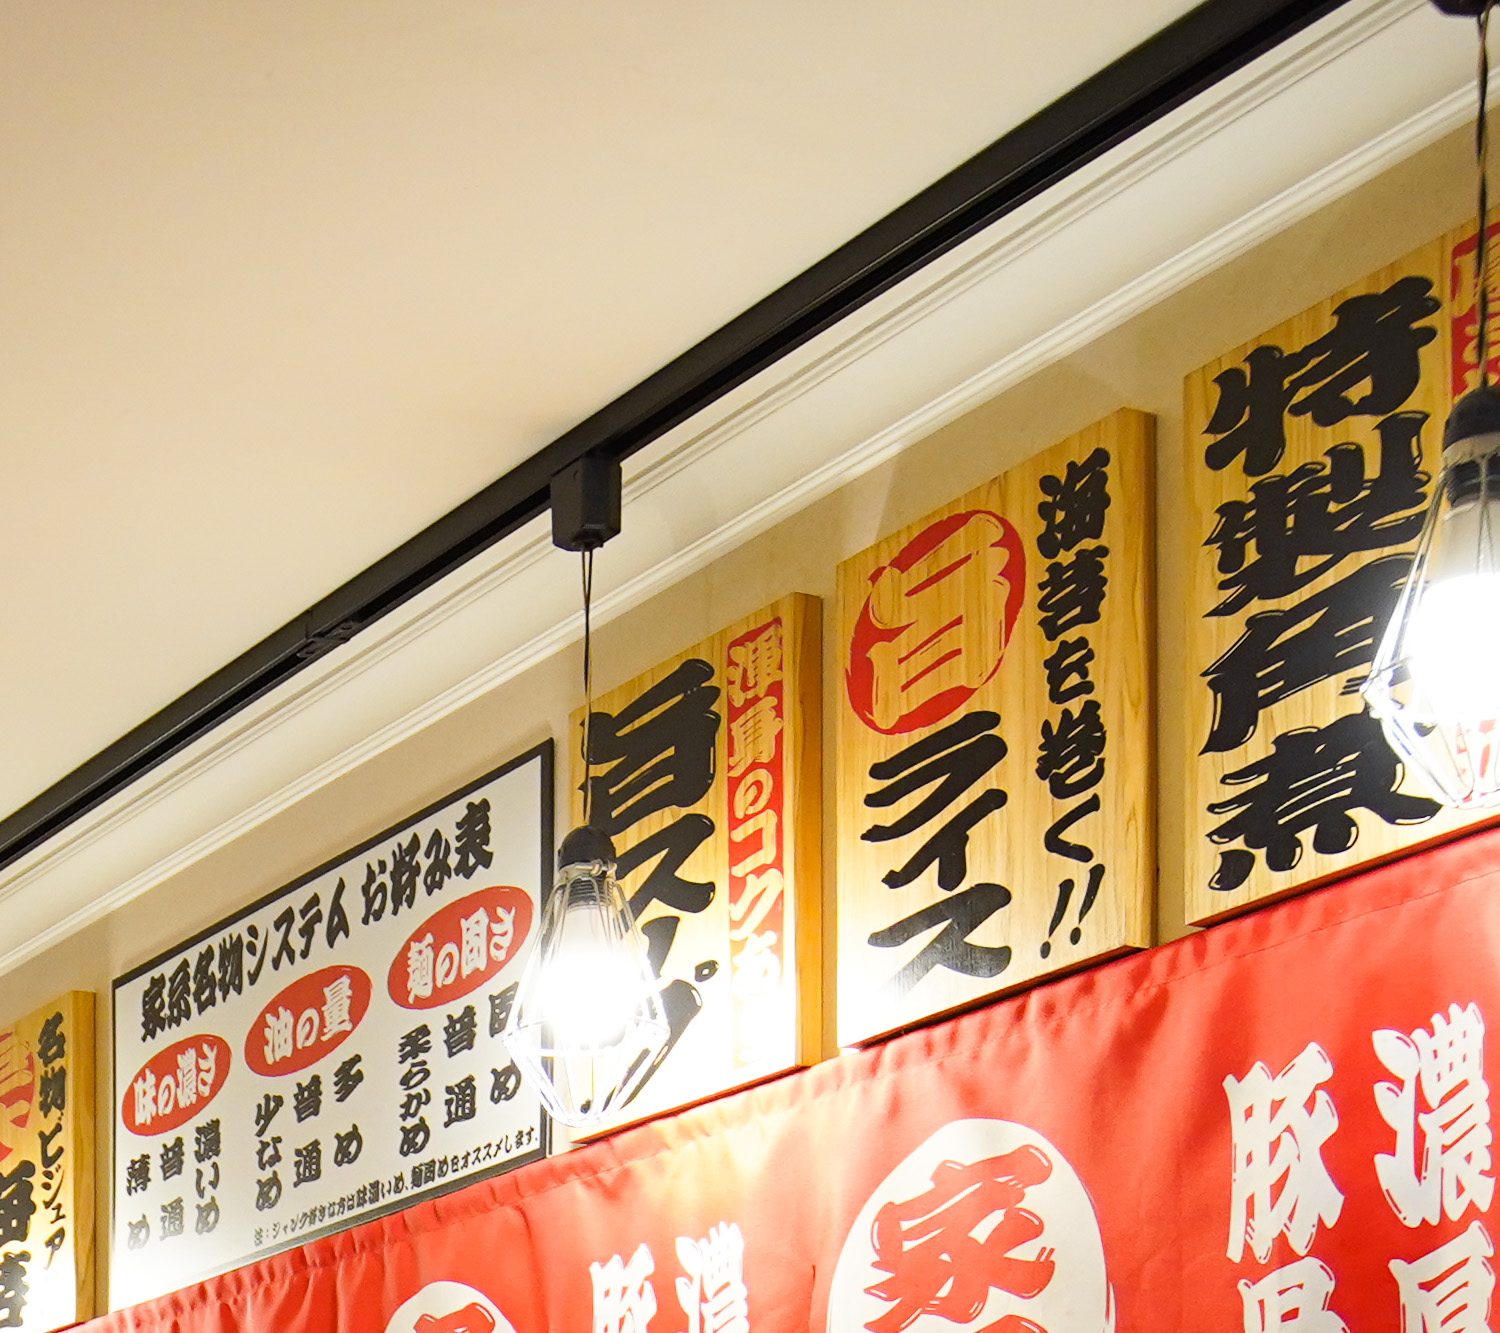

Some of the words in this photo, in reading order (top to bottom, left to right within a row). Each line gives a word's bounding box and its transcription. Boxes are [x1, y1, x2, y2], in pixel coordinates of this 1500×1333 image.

[1198, 275, 1443, 894] 特製角煮
[263, 974, 353, 1067] 油の量
[443, 1005, 478, 1128] 普通
[134, 1045, 220, 1126] 味の濃さ
[293, 1075, 324, 1189] 普通
[333, 1054, 364, 1166] 多め
[398, 1024, 431, 1158] 柔らかめ
[158, 1136, 185, 1242] 普通
[194, 1119, 221, 1235] 濃いめ
[255, 1093, 284, 1211] 少なめ
